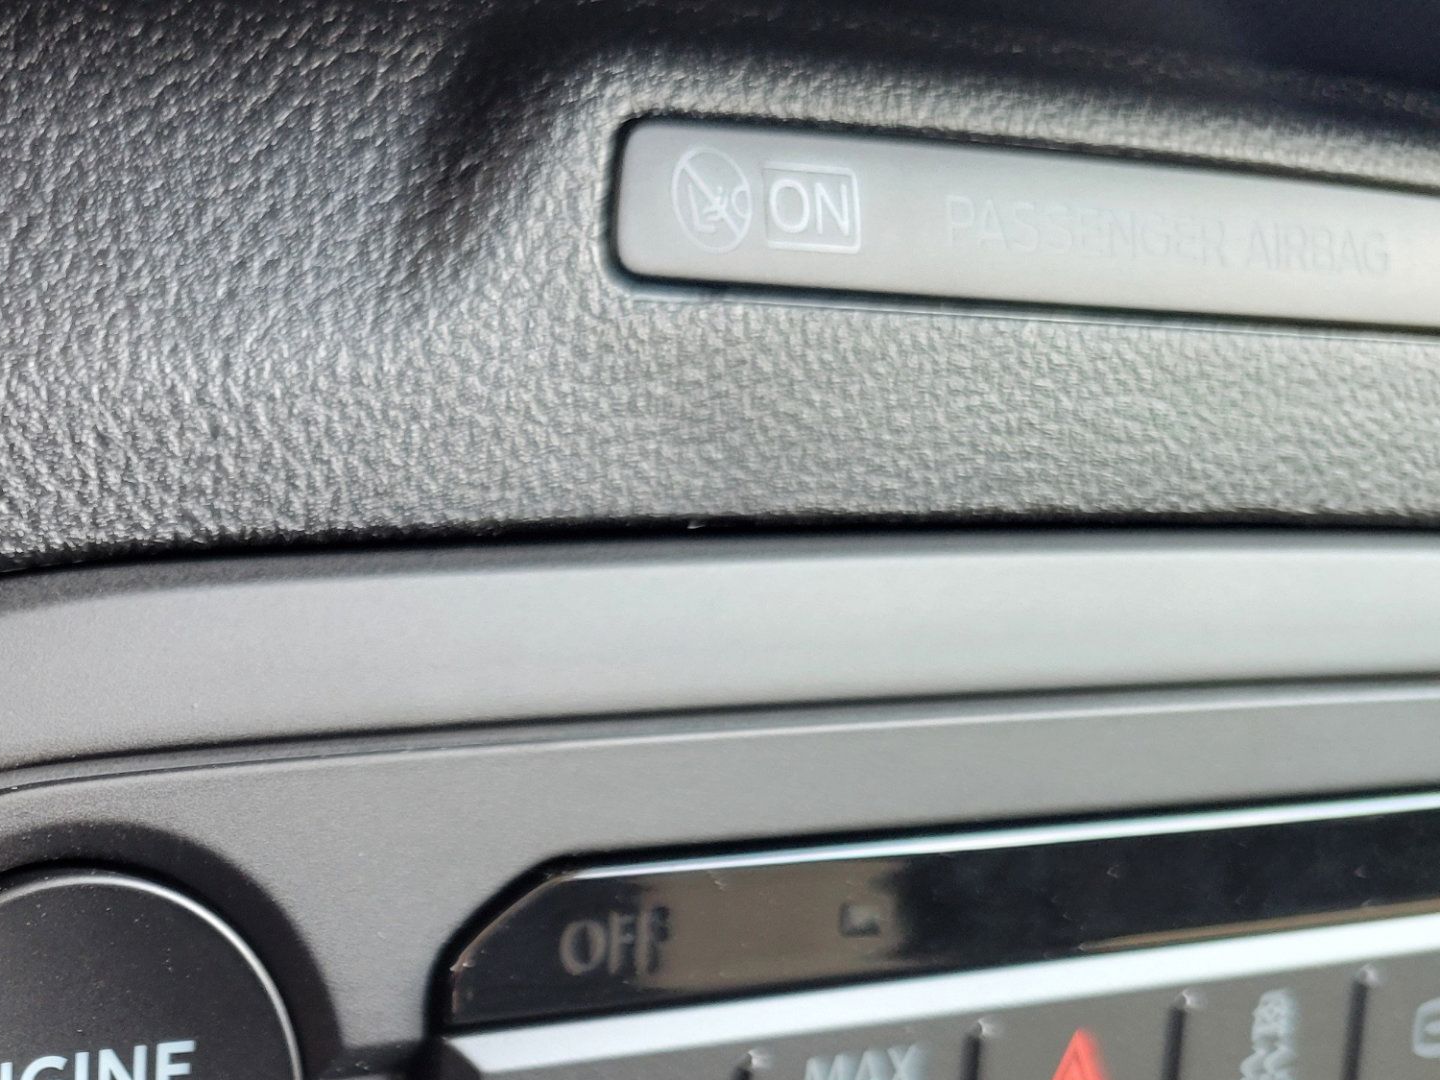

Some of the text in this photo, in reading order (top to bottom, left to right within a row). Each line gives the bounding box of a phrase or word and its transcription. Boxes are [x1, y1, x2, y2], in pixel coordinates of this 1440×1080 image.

[769, 177, 852, 237] ON
[947, 194, 1391, 278] PASSENGER AIRBAG
[560, 905, 671, 976] OFF
